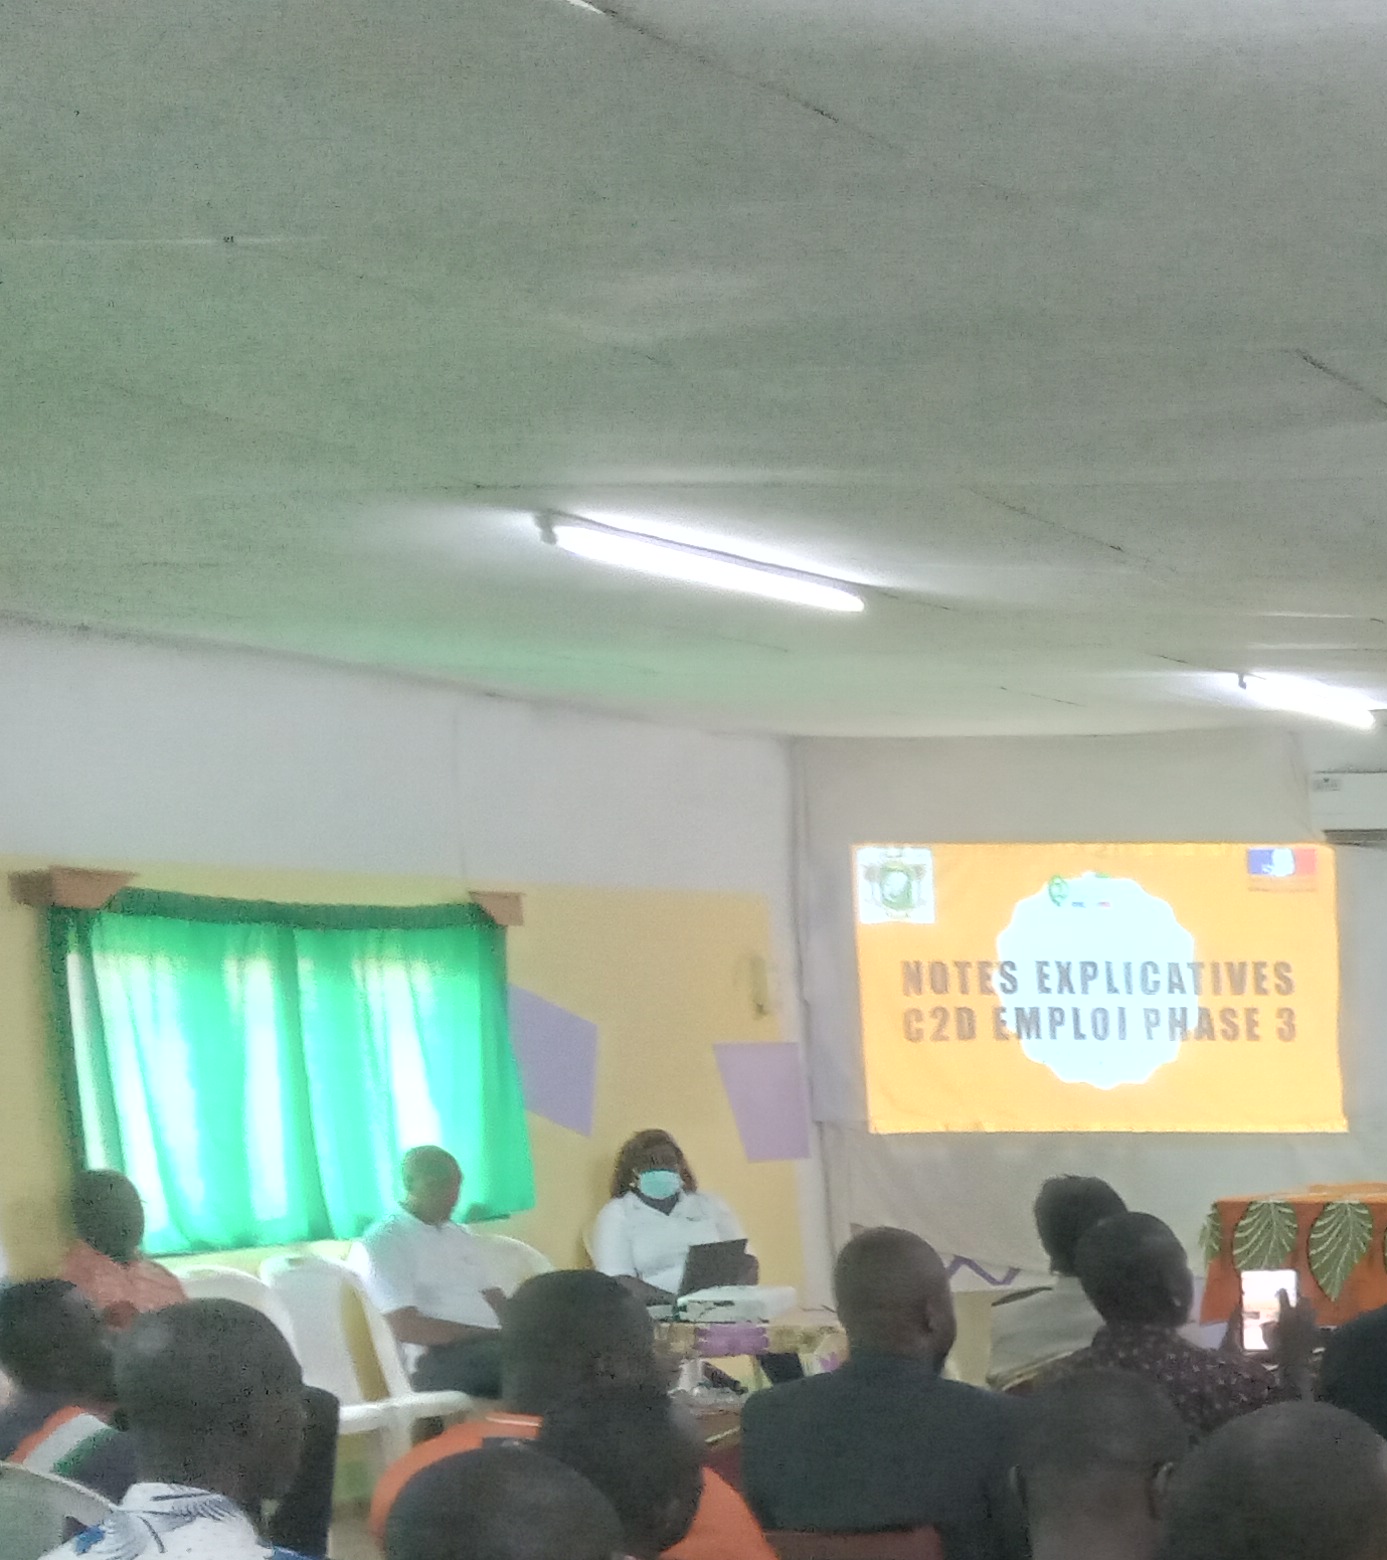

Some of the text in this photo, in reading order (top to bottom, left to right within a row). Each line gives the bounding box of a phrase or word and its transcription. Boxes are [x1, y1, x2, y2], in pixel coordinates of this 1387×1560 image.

[900, 959, 1297, 997] NOTES EXPLICATIVES
[902, 1005, 1298, 1044] C2D EMPLOI PHASE 3
